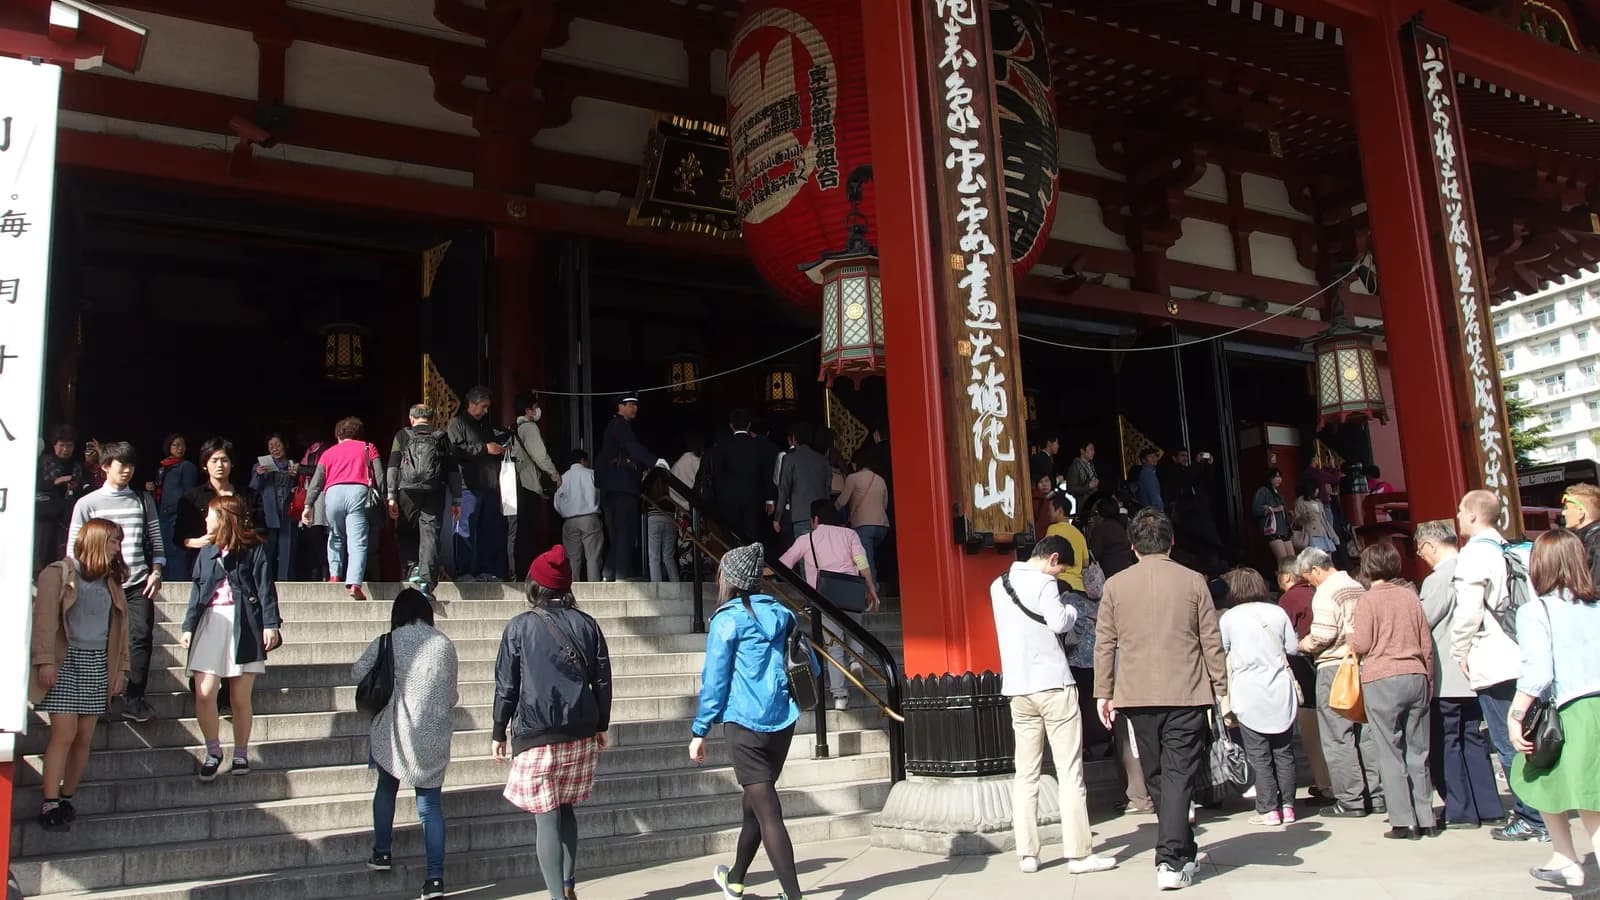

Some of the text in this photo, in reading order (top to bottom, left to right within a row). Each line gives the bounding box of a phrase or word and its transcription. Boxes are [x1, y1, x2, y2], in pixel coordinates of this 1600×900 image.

[809, 64, 839, 189] 東京新橋組合
